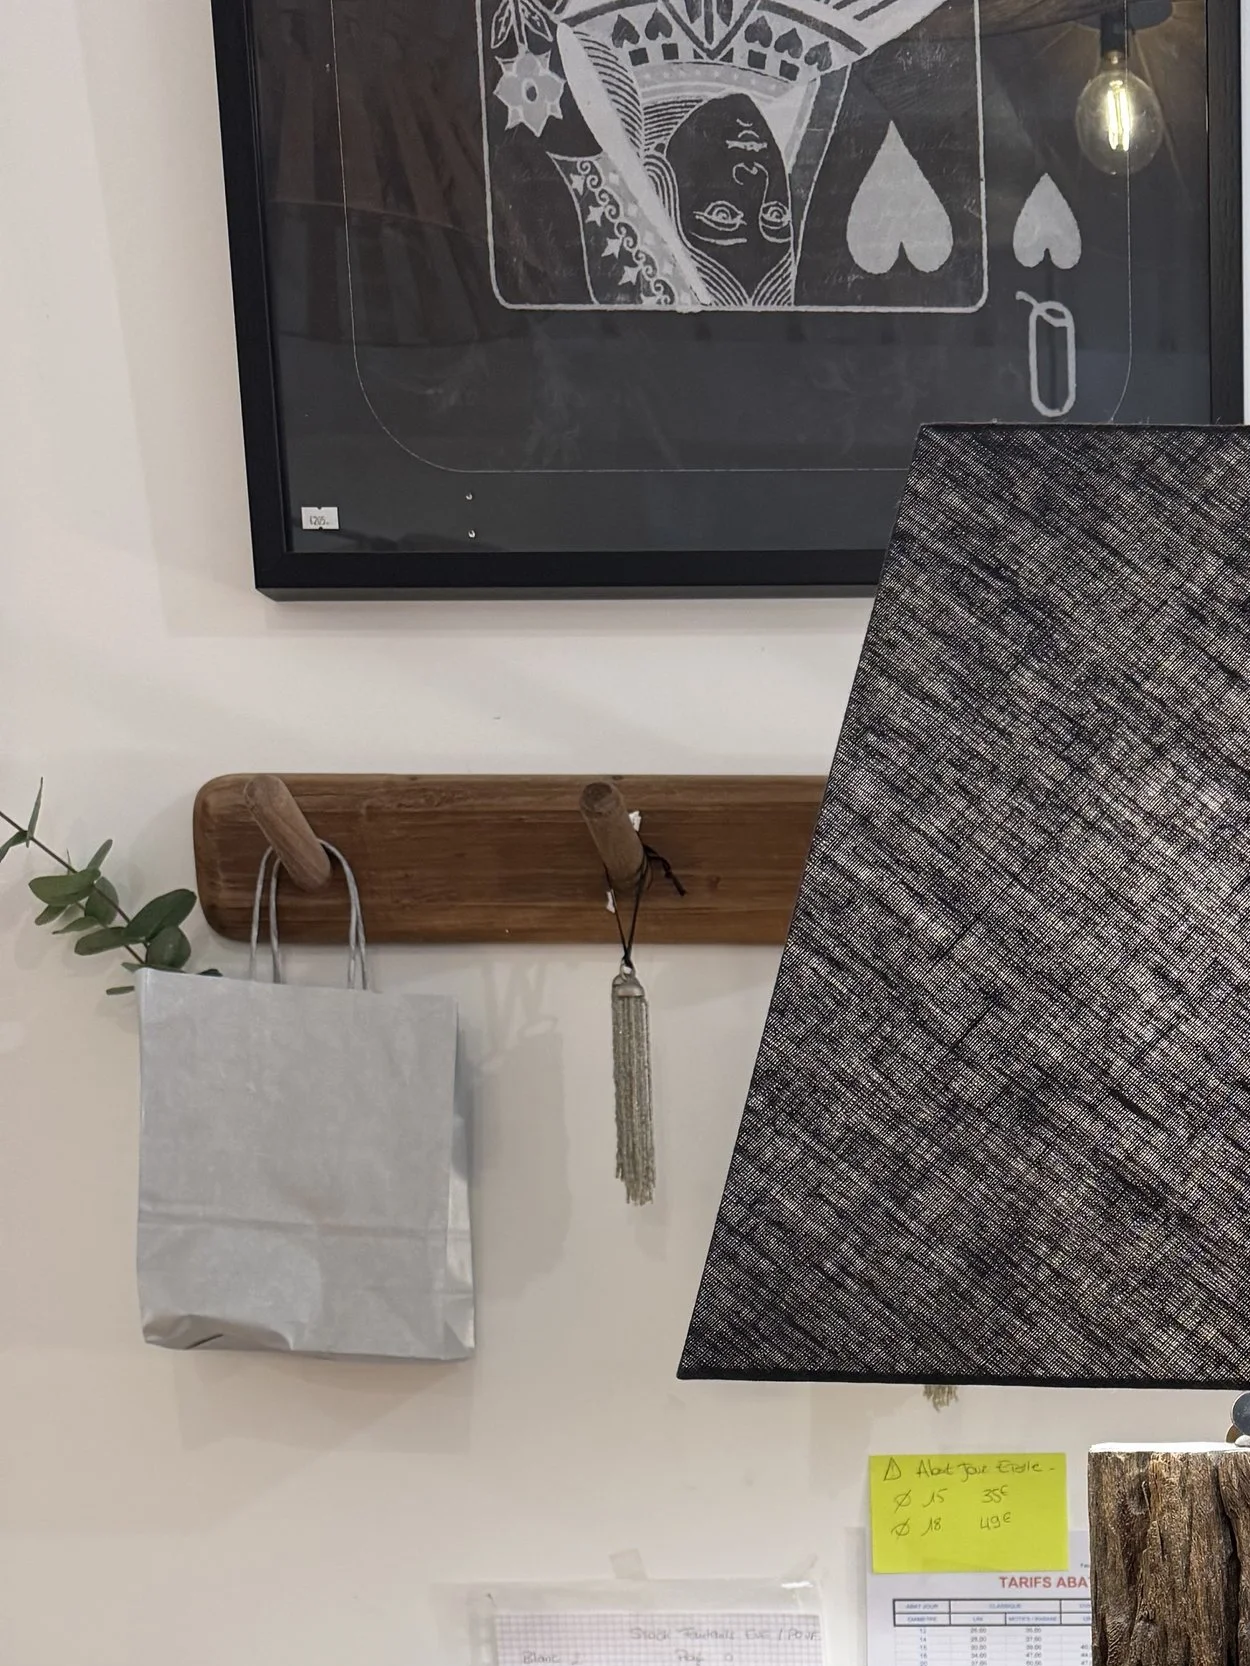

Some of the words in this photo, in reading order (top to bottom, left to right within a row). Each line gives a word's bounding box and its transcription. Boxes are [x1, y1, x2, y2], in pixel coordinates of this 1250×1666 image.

[923, 1488, 948, 1507] 15
[982, 1484, 1009, 1503] 35€
[921, 1518, 941, 1536] 18
[980, 1512, 1011, 1530] 49€
[999, 1576, 1052, 1589] TARIFS
[1056, 1576, 1090, 1589] ABA
[523, 1650, 561, 1664] Blanc
